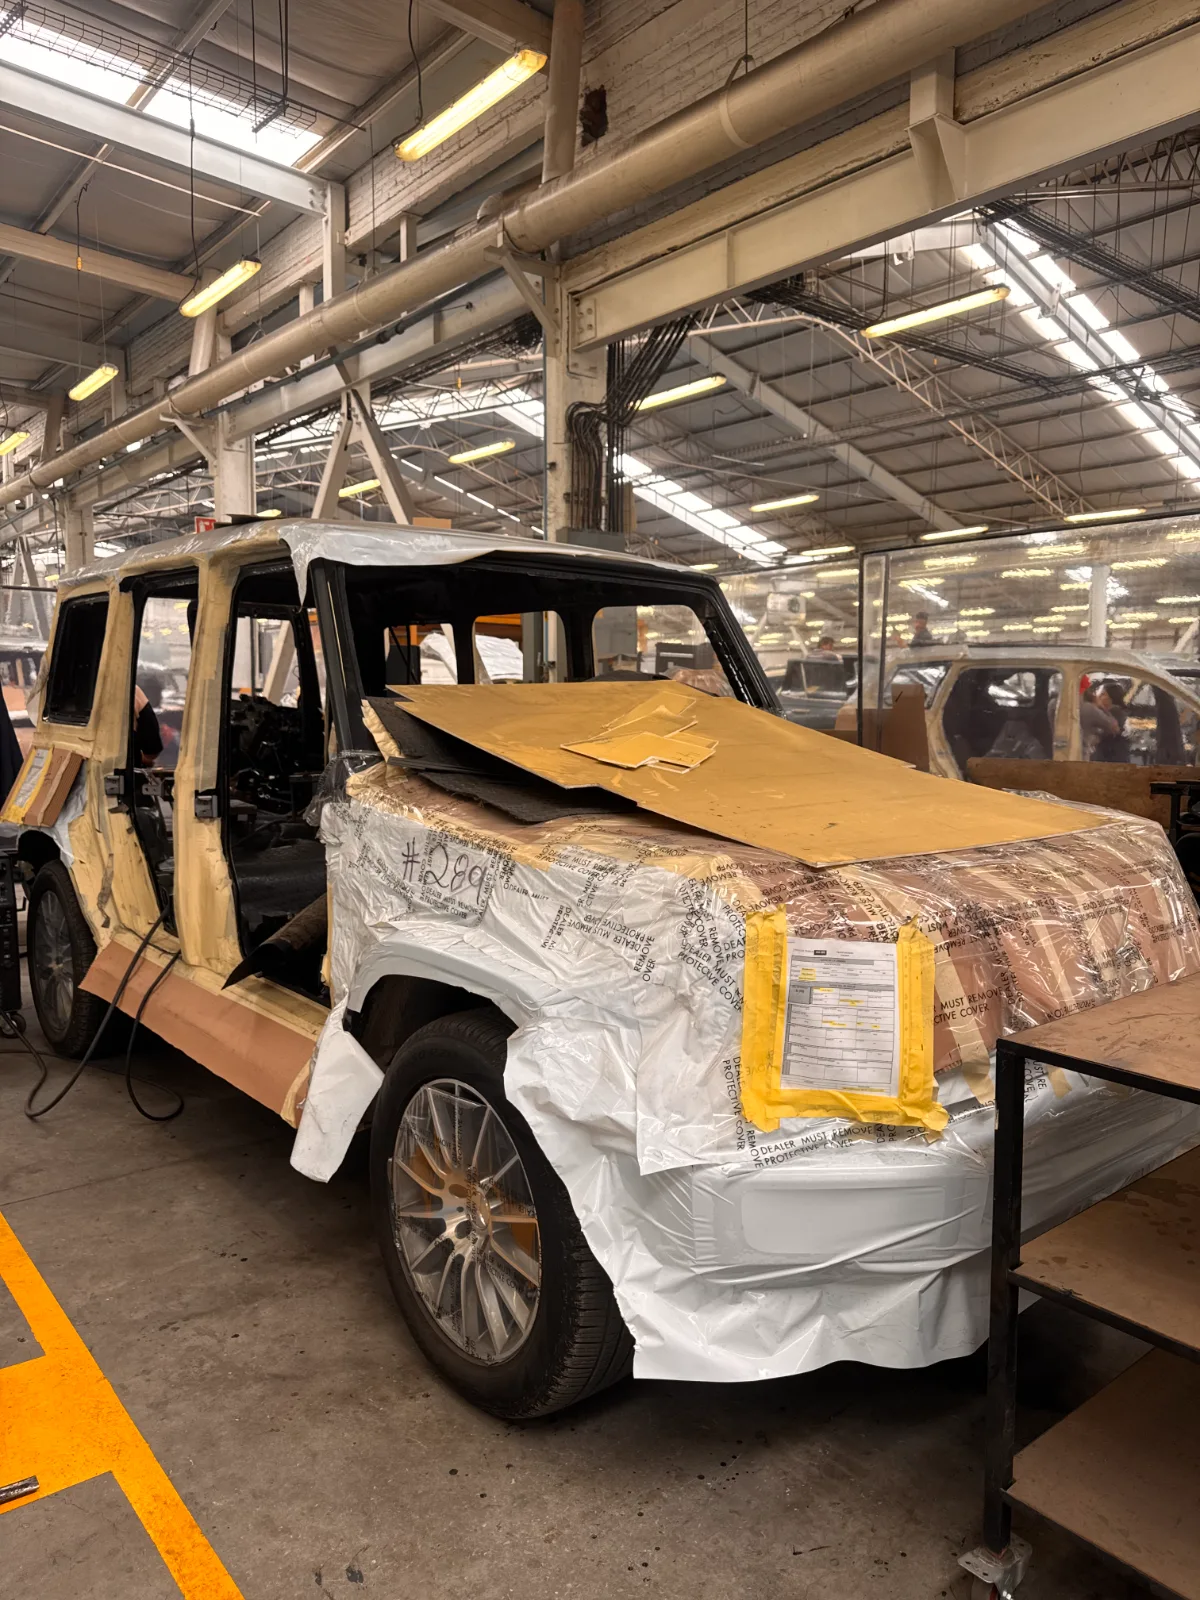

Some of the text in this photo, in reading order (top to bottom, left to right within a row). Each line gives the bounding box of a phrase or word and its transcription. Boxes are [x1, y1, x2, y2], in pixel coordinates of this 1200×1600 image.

[402, 836, 488, 906] #289
[572, 856, 590, 867] MUST
[484, 872, 494, 895] MUST
[762, 883, 787, 897] COVER
[556, 907, 572, 937] DEALER
[600, 918, 646, 942] PROTECTIVE
[695, 918, 708, 948] COVER
[948, 924, 972, 938] COVER
[613, 936, 642, 952] DEALER
[634, 936, 655, 973] REMOVE
[708, 926, 725, 968] REMOVE
[934, 940, 966, 953] REMOVE
[642, 958, 656, 982] OVER
[712, 964, 736, 987] MUST
[940, 986, 1003, 1012] MUST REMOVE
[1002, 972, 1016, 1005] DEALER
[960, 1004, 990, 1018] COVER
[723, 1060, 746, 1150] PROTECTIVE COVER
[746, 1130, 764, 1168] REMOVE
[760, 1125, 874, 1156] DEALER MUST REMOVE
[764, 1144, 820, 1166] PROTECTIVE
